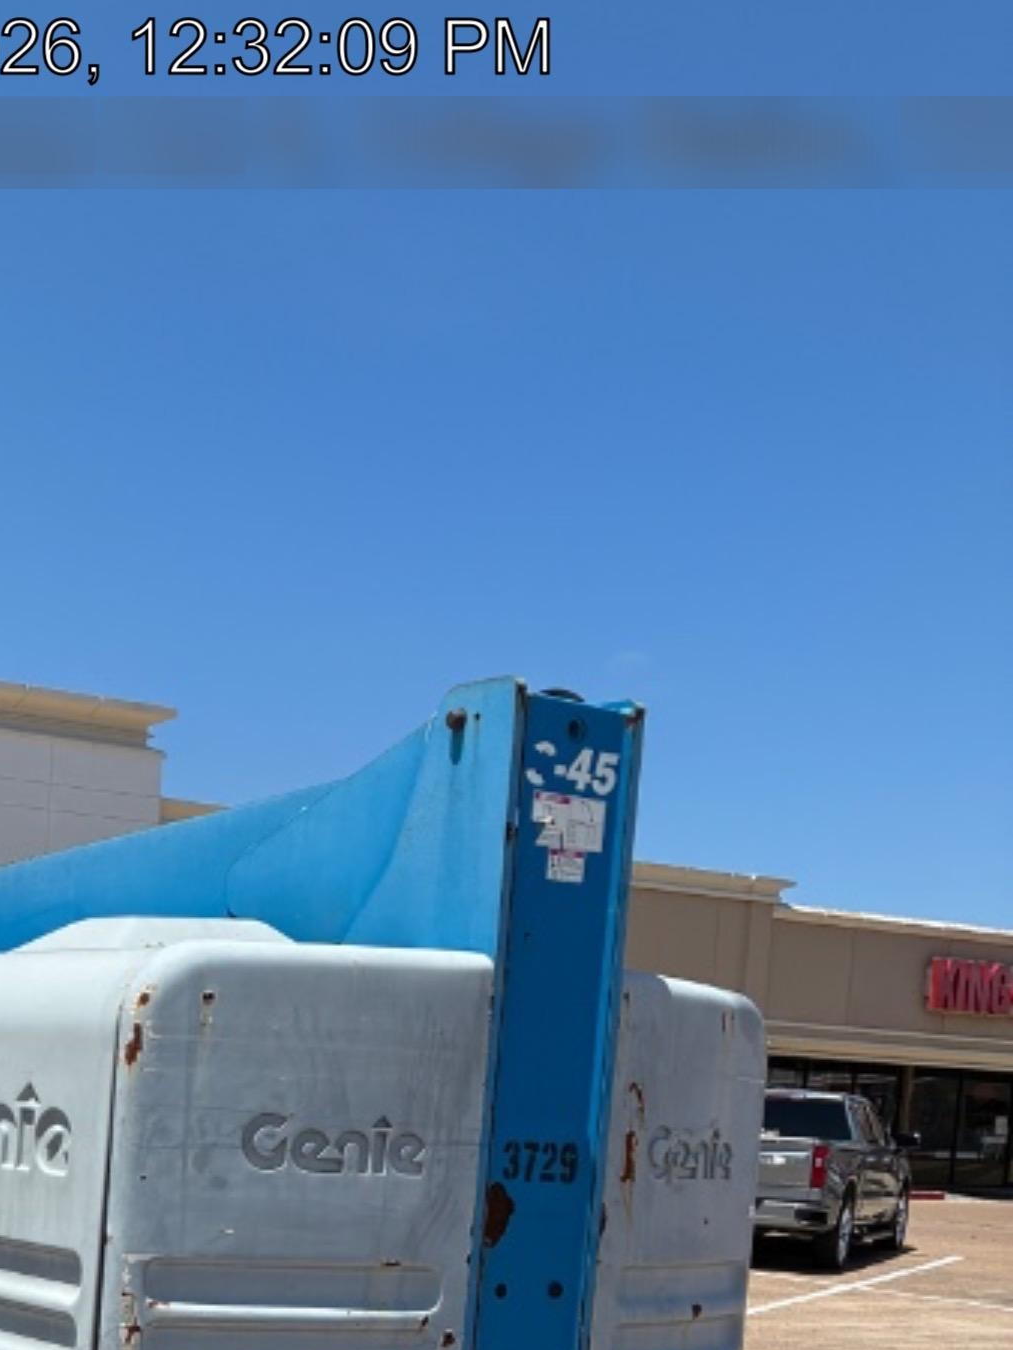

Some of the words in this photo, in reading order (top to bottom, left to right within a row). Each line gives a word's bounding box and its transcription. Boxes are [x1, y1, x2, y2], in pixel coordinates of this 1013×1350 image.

[242, 1112, 425, 1180] Genie
[503, 1141, 579, 1184] 3729
[648, 1124, 733, 1181] Genie
